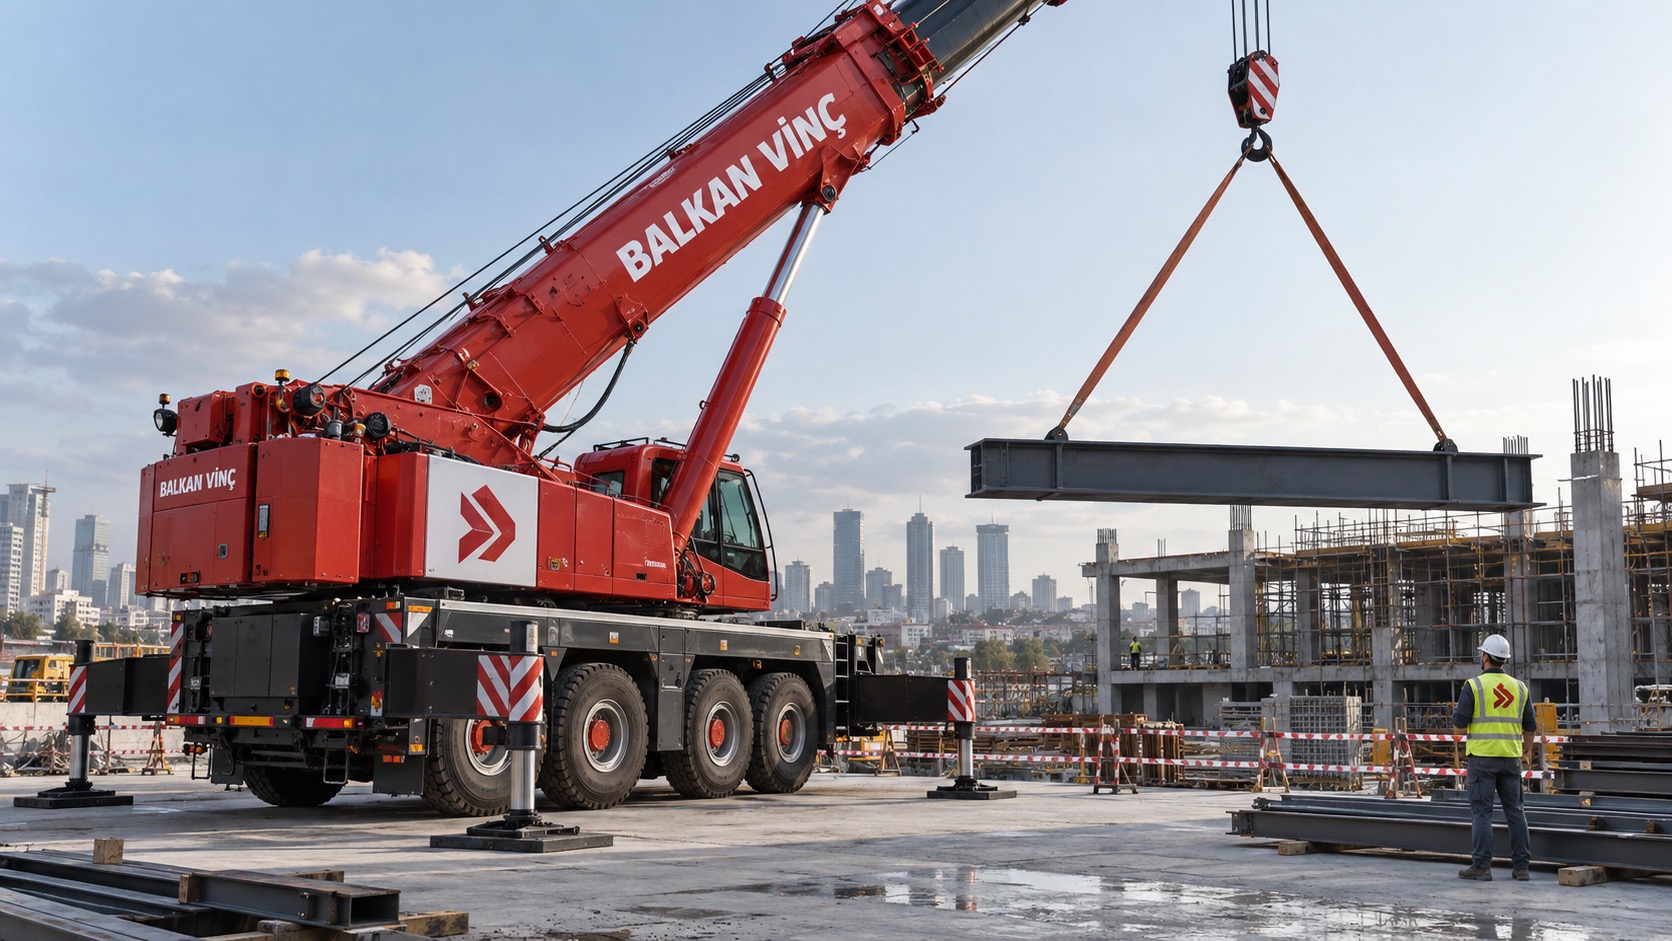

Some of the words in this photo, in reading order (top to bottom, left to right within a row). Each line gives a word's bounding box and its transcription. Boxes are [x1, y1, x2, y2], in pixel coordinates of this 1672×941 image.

[616, 154, 763, 283] BALKAN
[757, 92, 847, 173] VİNÇ
[160, 474, 202, 497] BALKAN
[206, 467, 236, 491] VİNÇ
